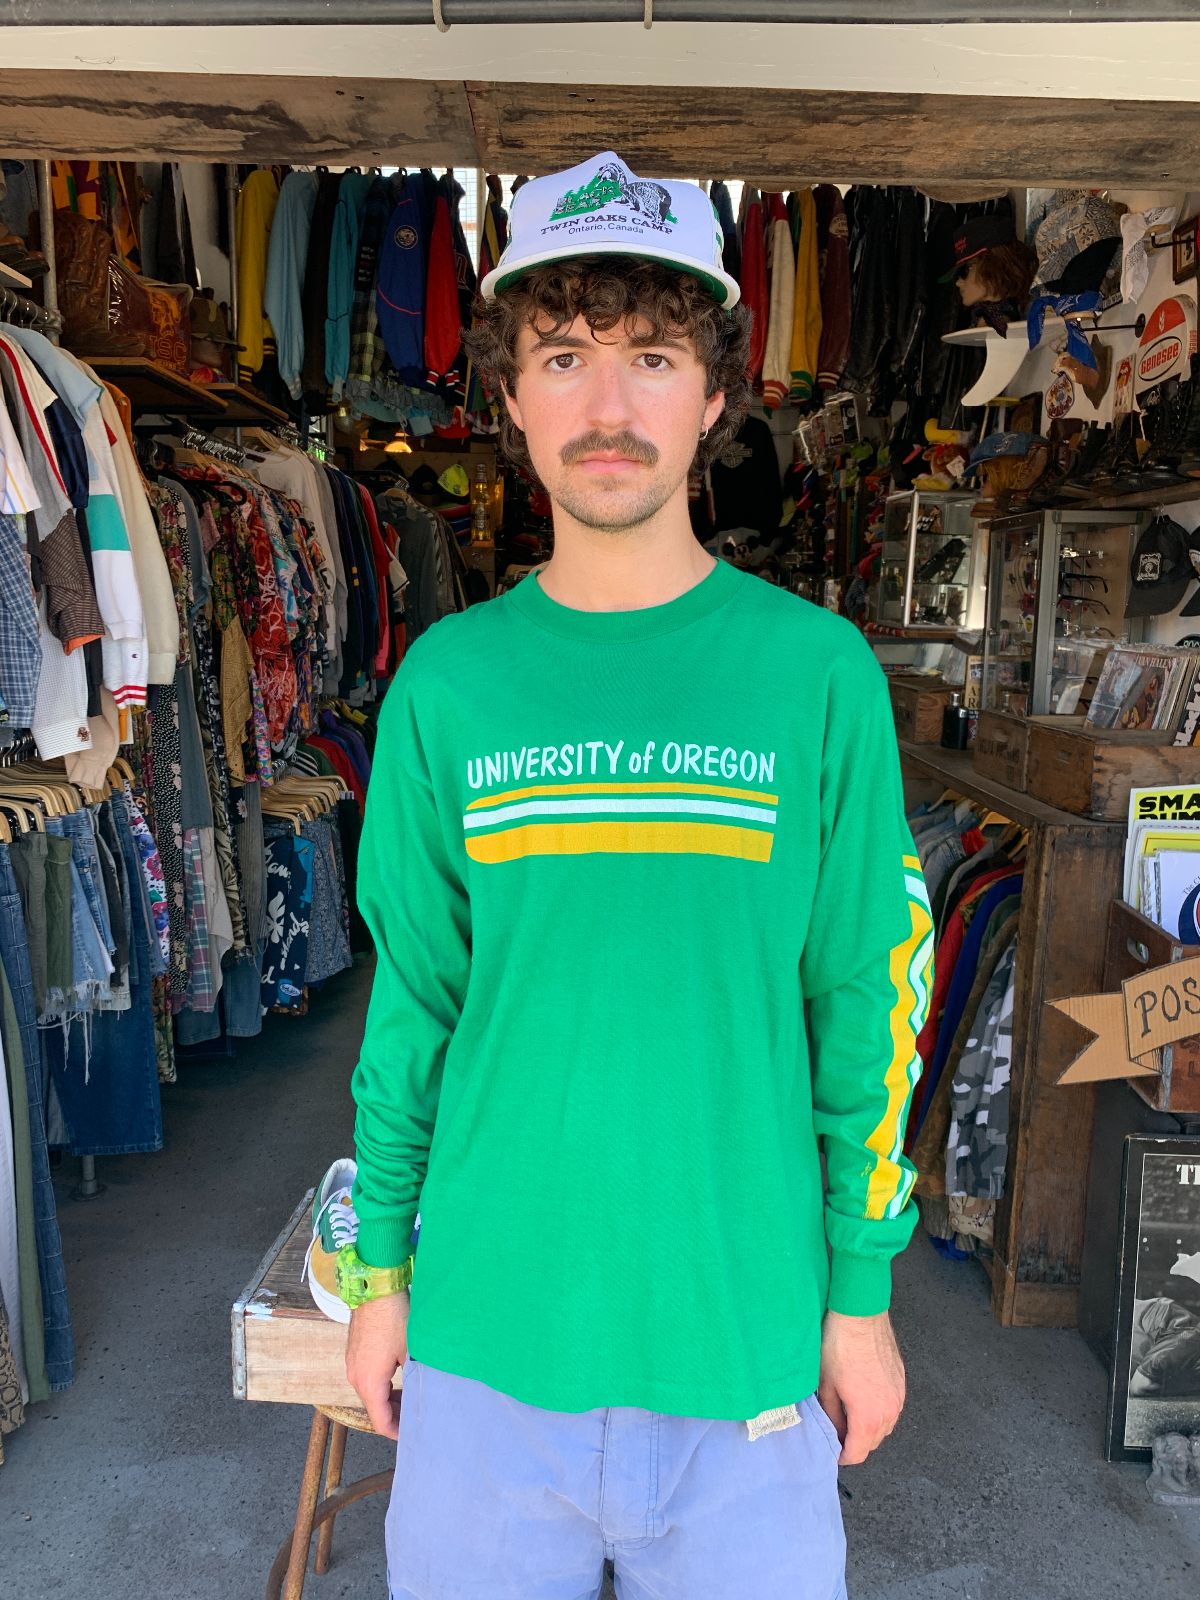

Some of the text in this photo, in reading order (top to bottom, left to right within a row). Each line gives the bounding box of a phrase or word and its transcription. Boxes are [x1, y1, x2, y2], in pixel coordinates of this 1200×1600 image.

[540, 214, 673, 235] TWIN OAKS CAMP
[568, 222, 644, 235] Ontario, Canada
[467, 739, 776, 789] UNIVERSITY of OREGON
[1133, 976, 1200, 1038] POS
